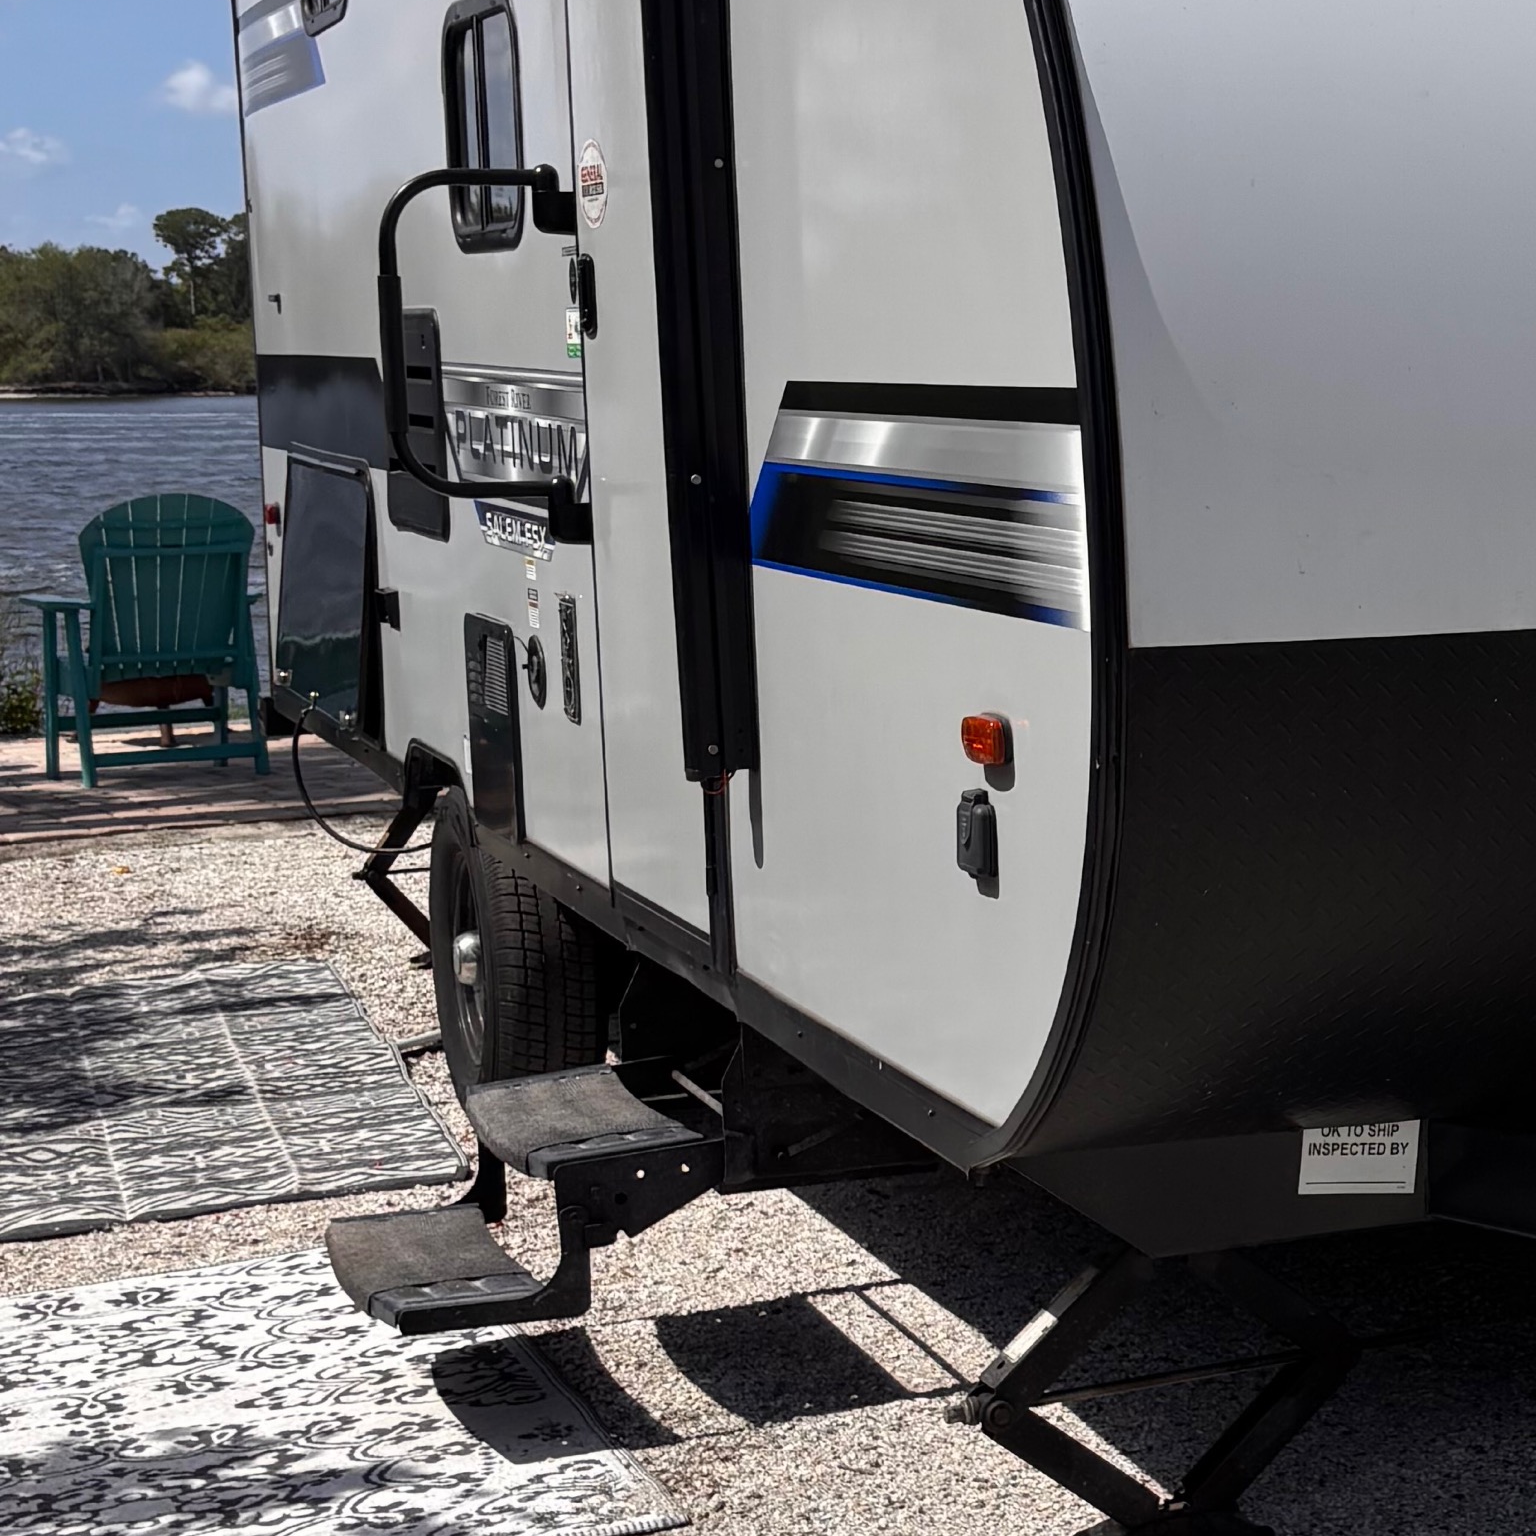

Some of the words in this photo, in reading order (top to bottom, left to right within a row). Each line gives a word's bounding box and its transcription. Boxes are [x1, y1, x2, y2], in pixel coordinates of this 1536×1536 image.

[455, 409, 579, 479] PLATINUM
[485, 512, 523, 546] SALEM
[1321, 1126, 1341, 1138] OK
[1368, 1123, 1400, 1138] SHIP
[1308, 1142, 1387, 1157] INSPECTED
[1390, 1142, 1410, 1156] BY
